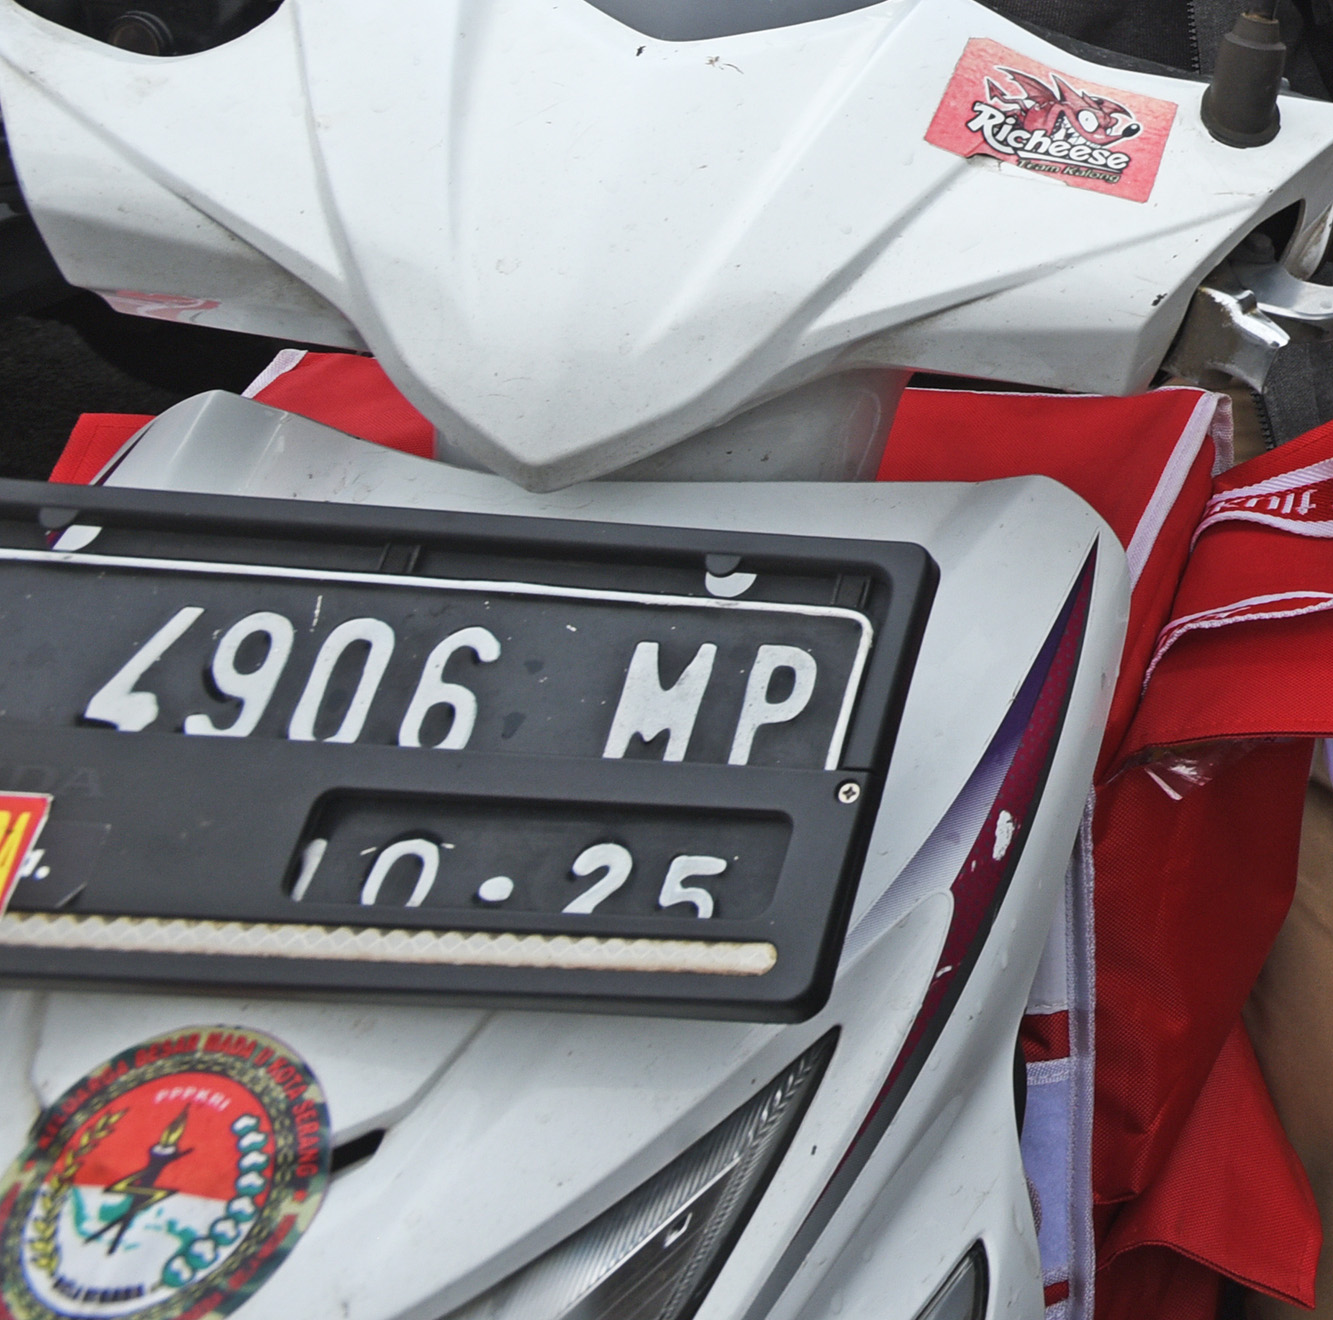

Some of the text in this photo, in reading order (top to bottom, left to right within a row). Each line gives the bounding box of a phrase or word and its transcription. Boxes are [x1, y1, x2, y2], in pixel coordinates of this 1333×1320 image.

[966, 101, 1132, 170] Richeese
[1018, 159, 1121, 184] Team Kalong
[602, 640, 818, 766] MP
[267, 1055, 307, 1101] KOTA
[292, 1098, 320, 1177] SERANG
